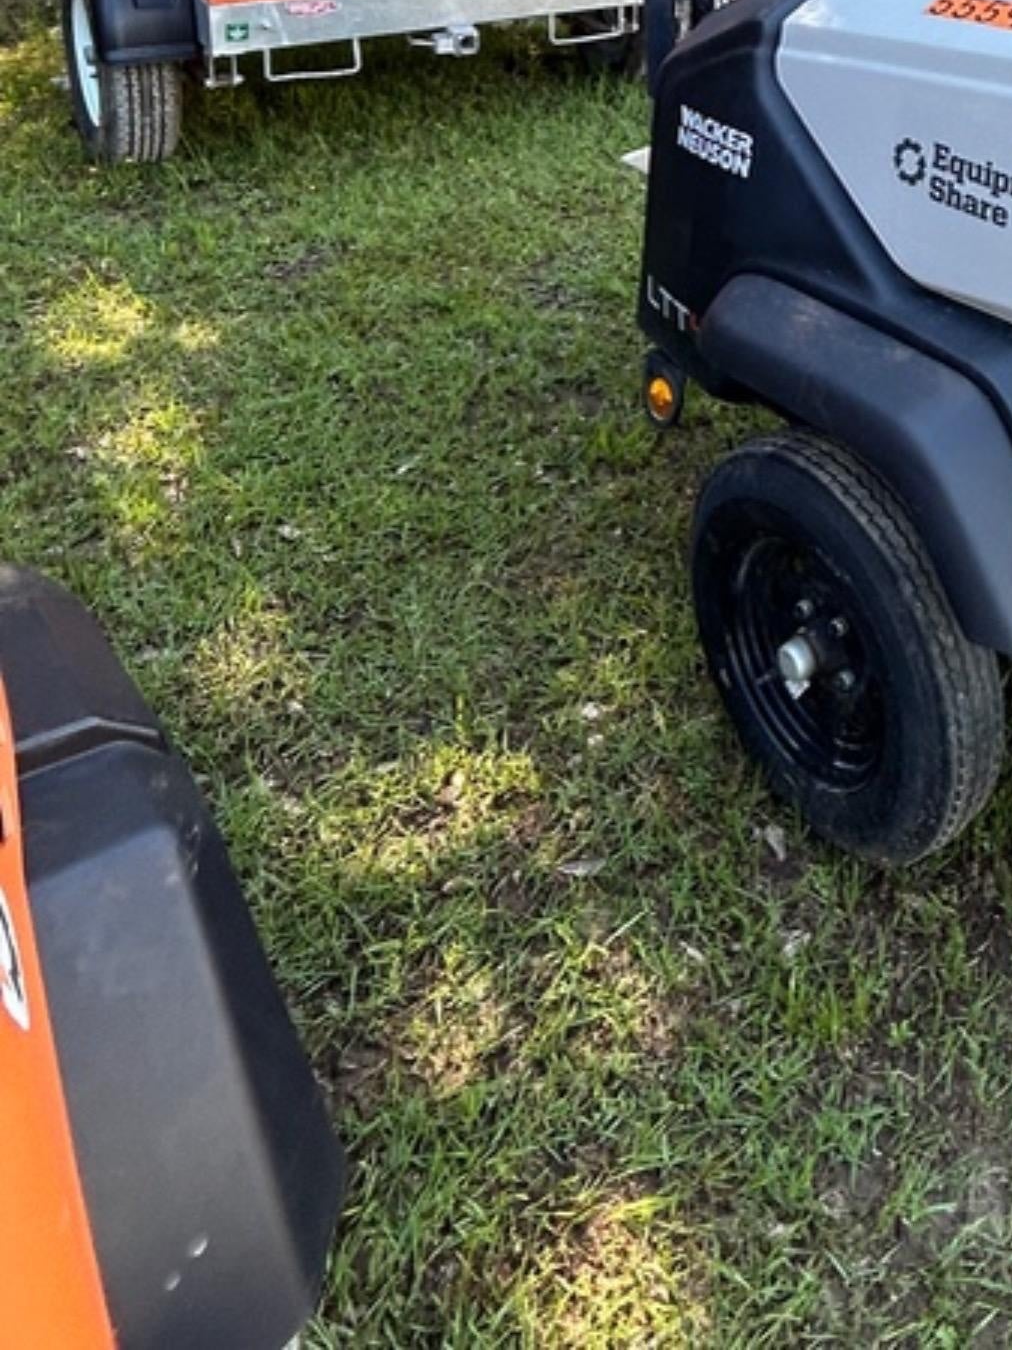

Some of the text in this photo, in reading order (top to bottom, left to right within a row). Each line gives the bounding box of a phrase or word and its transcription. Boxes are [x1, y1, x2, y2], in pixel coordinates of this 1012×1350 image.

[677, 125, 751, 179] NEUSON
[680, 103, 754, 155] WACKER
[928, 174, 1009, 229] Share
[647, 274, 697, 331] LTT
